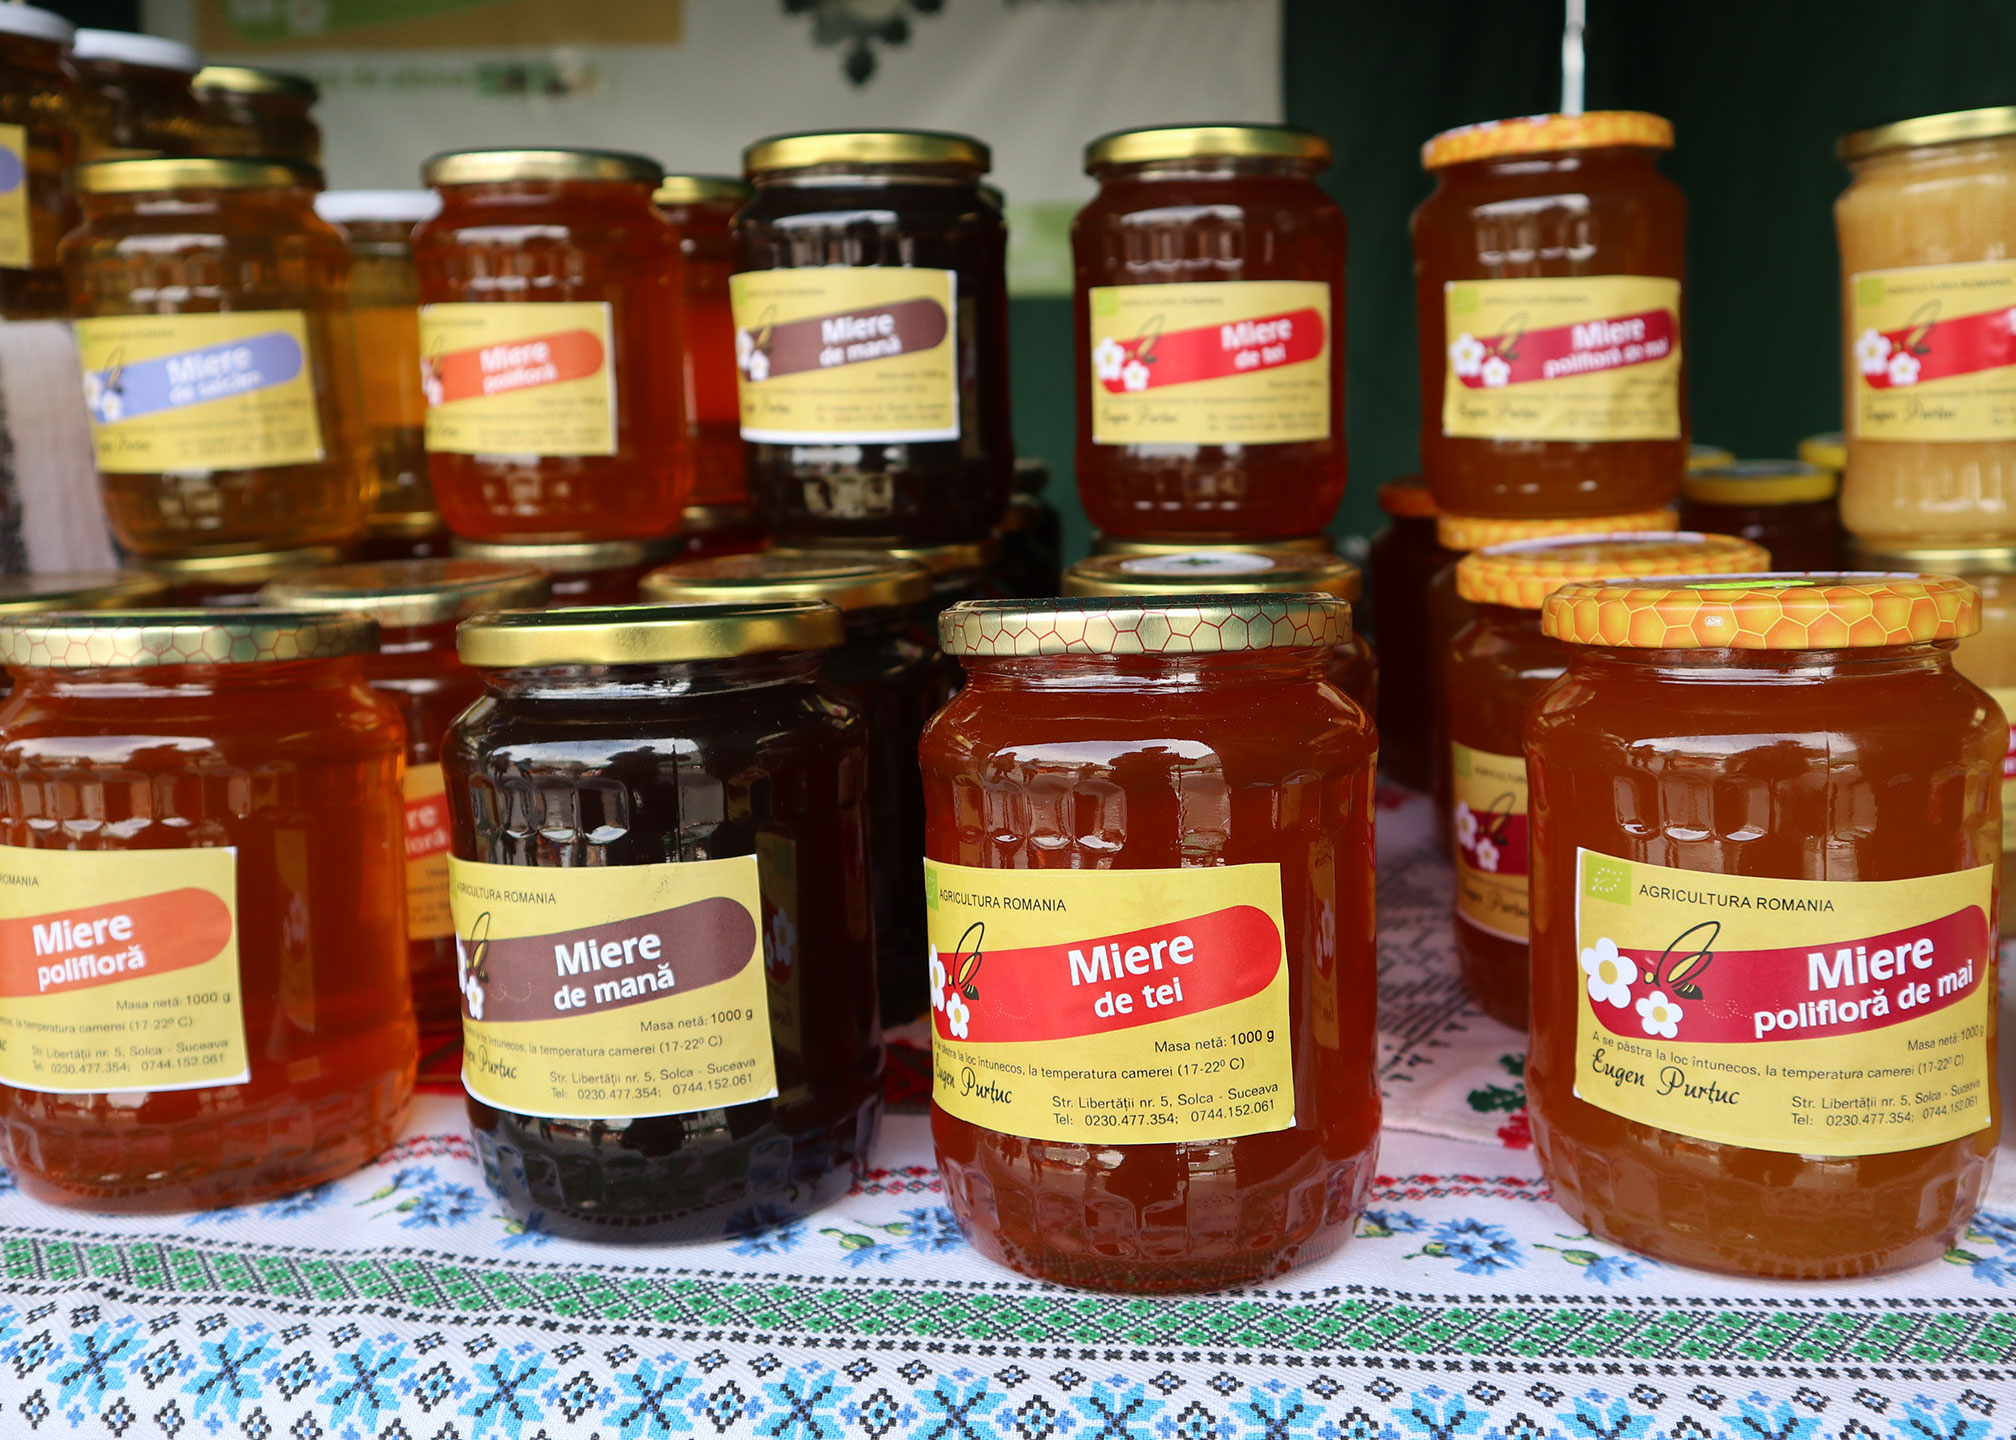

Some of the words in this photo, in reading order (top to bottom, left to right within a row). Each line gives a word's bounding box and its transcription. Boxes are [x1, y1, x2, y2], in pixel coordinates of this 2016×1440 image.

[821, 314, 895, 345] Miere
[1221, 318, 1293, 350] Miere
[1571, 318, 1646, 351] Miere
[166, 346, 251, 386] Miere
[480, 341, 549, 373] Miere
[818, 347, 845, 368] de
[1233, 349, 1260, 369] de
[1623, 344, 1644, 362] de
[504, 889, 557, 904] ROMANIA
[940, 889, 1001, 909] AGRICULTURA
[1003, 897, 1067, 911] ROMANIA
[1639, 884, 1752, 909] AGRICULTURA
[1756, 897, 1835, 912] ROMANIA
[32, 914, 133, 956] Miere
[37, 944, 147, 992] polifloră
[554, 933, 661, 977] Miere
[1067, 935, 1195, 987] Miere
[1807, 937, 1934, 991] Miere
[553, 984, 586, 1010] de
[593, 962, 676, 1004] mană
[1094, 991, 1133, 1018] de
[1141, 976, 1184, 1009] tei
[1754, 987, 1890, 1039] polifloră
[1898, 982, 1931, 1010] de
[1937, 959, 1974, 998] mai
[116, 1000, 148, 1010] Masa
[186, 992, 218, 1005] 1000
[222, 992, 231, 1004] g
[79, 1022, 125, 1033] camerei
[177, 1015, 193, 1027] C)
[640, 1021, 674, 1032] Masa
[678, 1015, 708, 1028] netă:
[711, 1008, 742, 1024] 1000
[745, 1008, 753, 1021] g
[129, 1045, 163, 1057] Solca
[176, 1040, 228, 1053] Suceava
[540, 1045, 605, 1058] temperatura
[608, 1043, 655, 1056] camerei
[708, 1035, 723, 1048] C)
[1154, 1041, 1191, 1052] Masa
[1195, 1036, 1227, 1050] netă:
[1230, 1029, 1263, 1046] 1000
[1266, 1029, 1275, 1043] g
[1908, 1040, 1936, 1051] Masa
[1938, 1033, 1960, 1046] netă:
[1961, 1024, 1979, 1041] 1000
[1979, 1025, 1985, 1037] g
[965, 1052, 977, 1066] loc
[1028, 1063, 1038, 1076] la
[1041, 1067, 1117, 1081] temperatura
[1121, 1066, 1173, 1079] camerei
[1229, 1057, 1245, 1070] C)
[1592, 1031, 1600, 1042] A
[1602, 1036, 1614, 1048] se
[1656, 1048, 1667, 1061] la
[1671, 1051, 1689, 1066] loc
[1766, 1064, 1777, 1076] la
[1782, 1066, 1864, 1081] temperatura
[1867, 1064, 1915, 1078] camerei
[1954, 1054, 1965, 1067] C)
[1592, 1047, 1646, 1088] Eugen
[549, 1071, 568, 1083] Str.
[625, 1074, 639, 1083] nr.
[660, 1067, 694, 1081] Solca
[706, 1059, 756, 1075] Suceava
[551, 1087, 568, 1099] Tel:
[577, 1087, 661, 1100] 0230.477.354;
[672, 1073, 752, 1096] 0744.152.061
[1052, 1095, 1074, 1108] Str.
[1139, 1098, 1155, 1108] nr.
[1177, 1093, 1214, 1106] Solca
[1228, 1083, 1279, 1101] Suceava
[1792, 1095, 1816, 1108] Str.
[1881, 1097, 1896, 1107] nr.
[1915, 1090, 1941, 1104] Solca
[1951, 1079, 1981, 1097] Suceava
[1053, 1112, 1073, 1126] Tel:
[1085, 1112, 1179, 1127] 0230.477.354;
[1190, 1099, 1275, 1123] 0744.152.061
[1791, 1112, 1813, 1126] Tel:
[1826, 1111, 1915, 1127] 0230.477.354;
[1922, 1095, 1979, 1120] 0744.152.061
